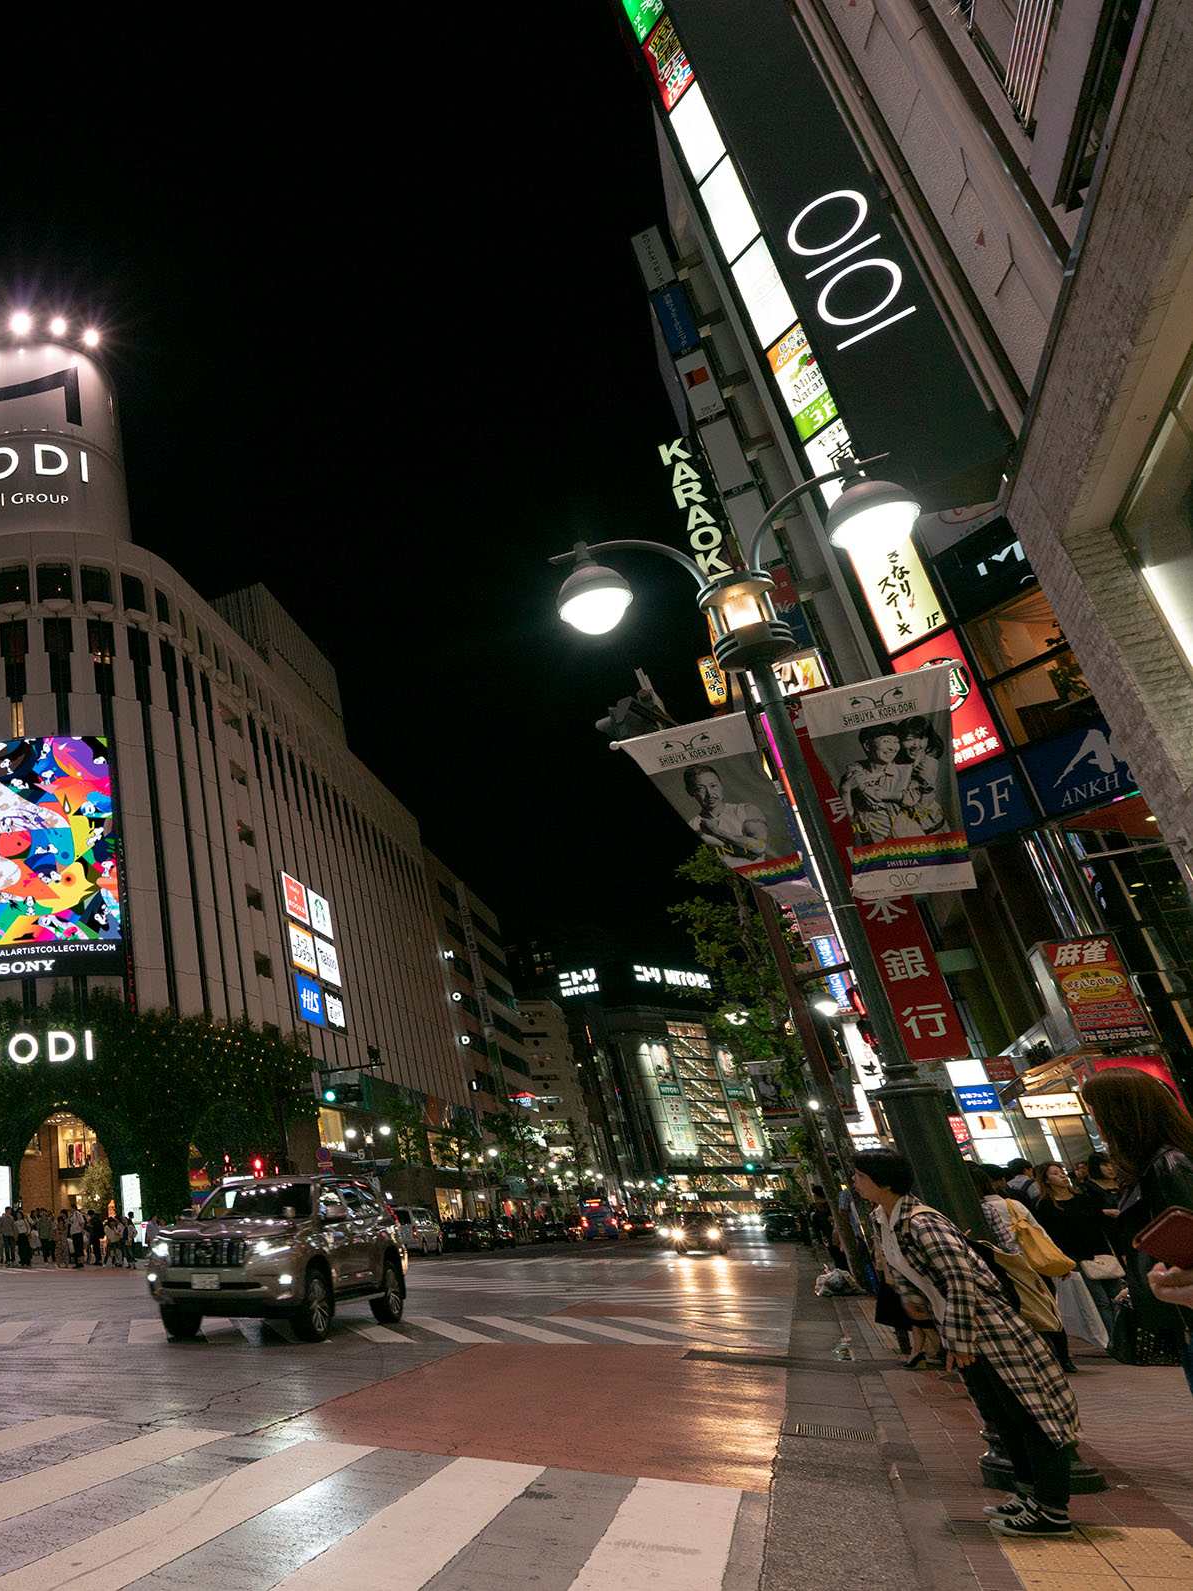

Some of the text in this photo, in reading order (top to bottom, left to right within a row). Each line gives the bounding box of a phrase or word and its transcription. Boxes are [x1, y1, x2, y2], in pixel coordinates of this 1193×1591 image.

[10, 491, 69, 506] GROUP
[657, 436, 736, 583] KARAOK
[877, 576, 913, 636] ステーキ
[842, 711, 875, 727] SHIBUYA
[659, 752, 687, 767] SHIBUYA
[1060, 772, 1120, 808] ANKH
[966, 774, 1013, 827] 5F
[886, 858, 920, 868] SHIBUYA
[1053, 939, 1110, 967] 麻雀
[558, 967, 597, 988] ニトリ
[1064, 975, 1123, 991] WELCOME
[561, 983, 600, 998] NITORI
[660, 1086, 680, 1094] NITORI
[965, 1098, 993, 1106] クリニック
